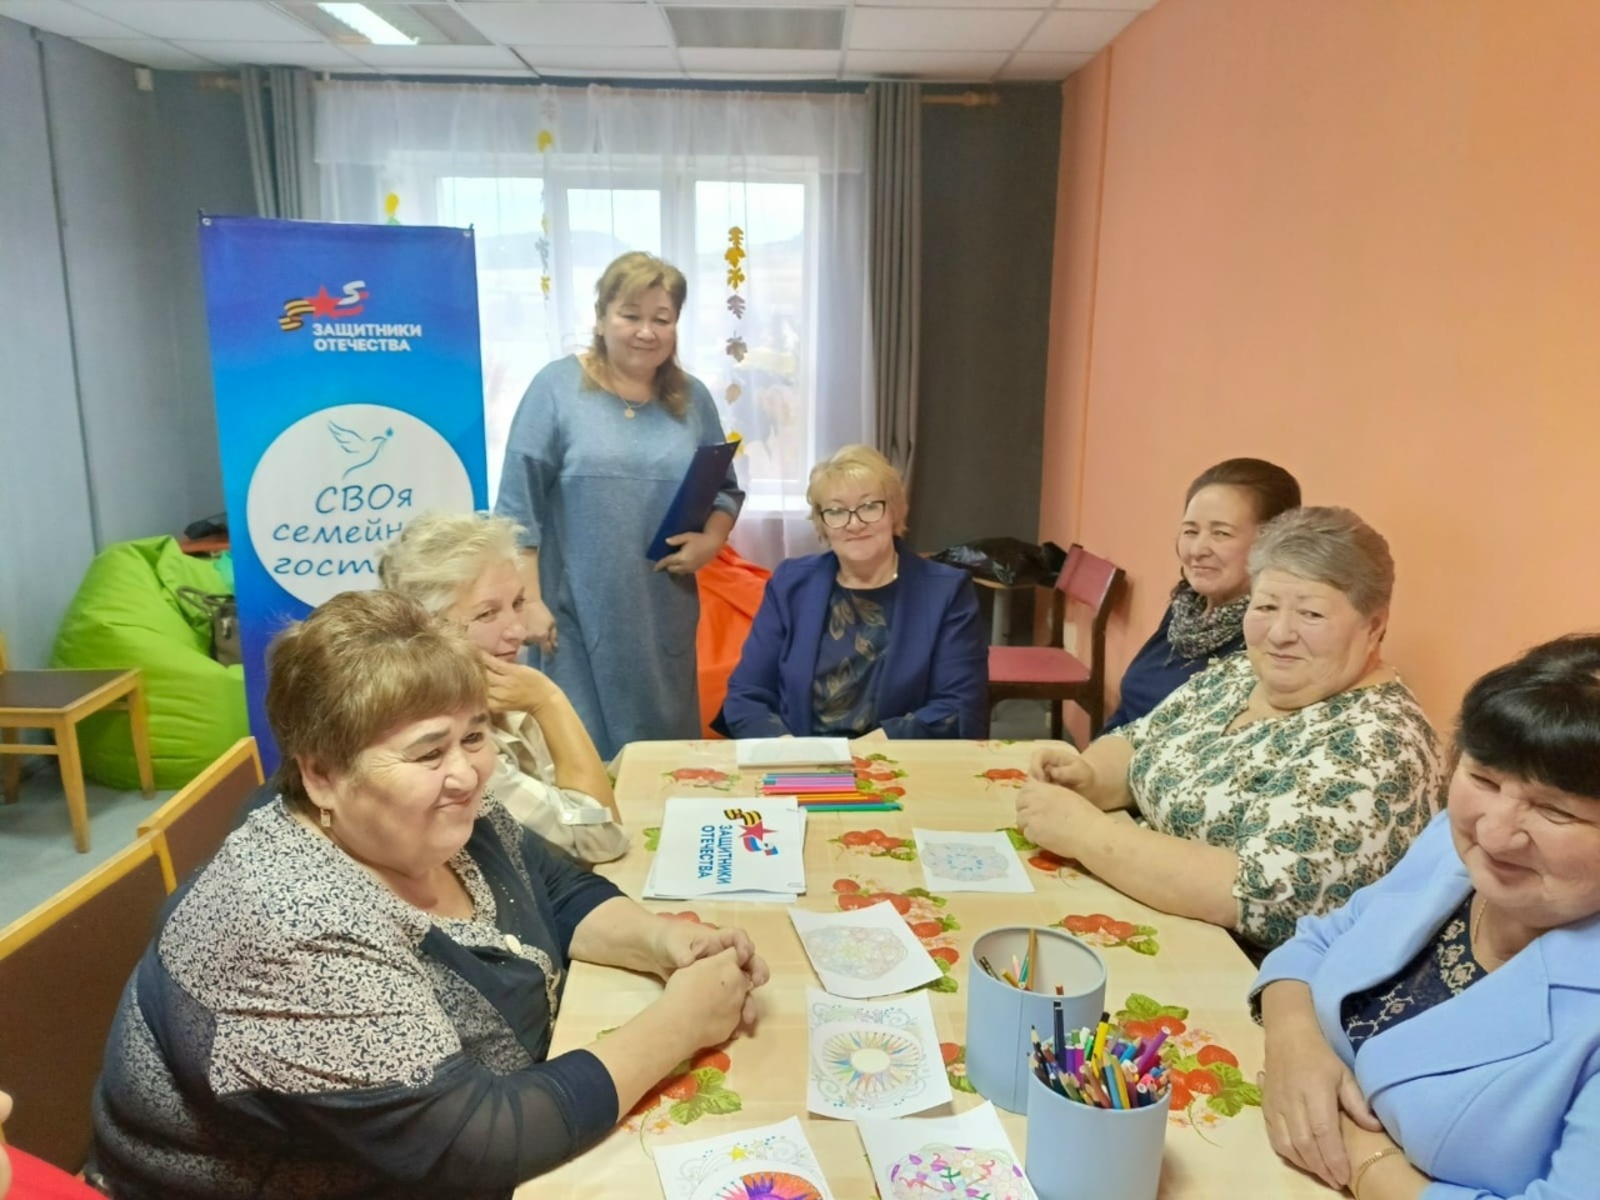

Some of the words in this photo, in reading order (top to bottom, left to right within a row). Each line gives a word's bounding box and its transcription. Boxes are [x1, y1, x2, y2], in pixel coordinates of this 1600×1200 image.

[313, 322, 422, 338] ЗАЩИТНИКИ
[314, 338, 411, 352] ОТЕЧЕСТВА
[315, 483, 413, 514] СВОя
[272, 518, 403, 544] семейн
[273, 557, 376, 577] гост
[698, 825, 715, 879] ОТЕЧЕСТВА
[716, 824, 733, 884] ЗАЩИТНИКИ
